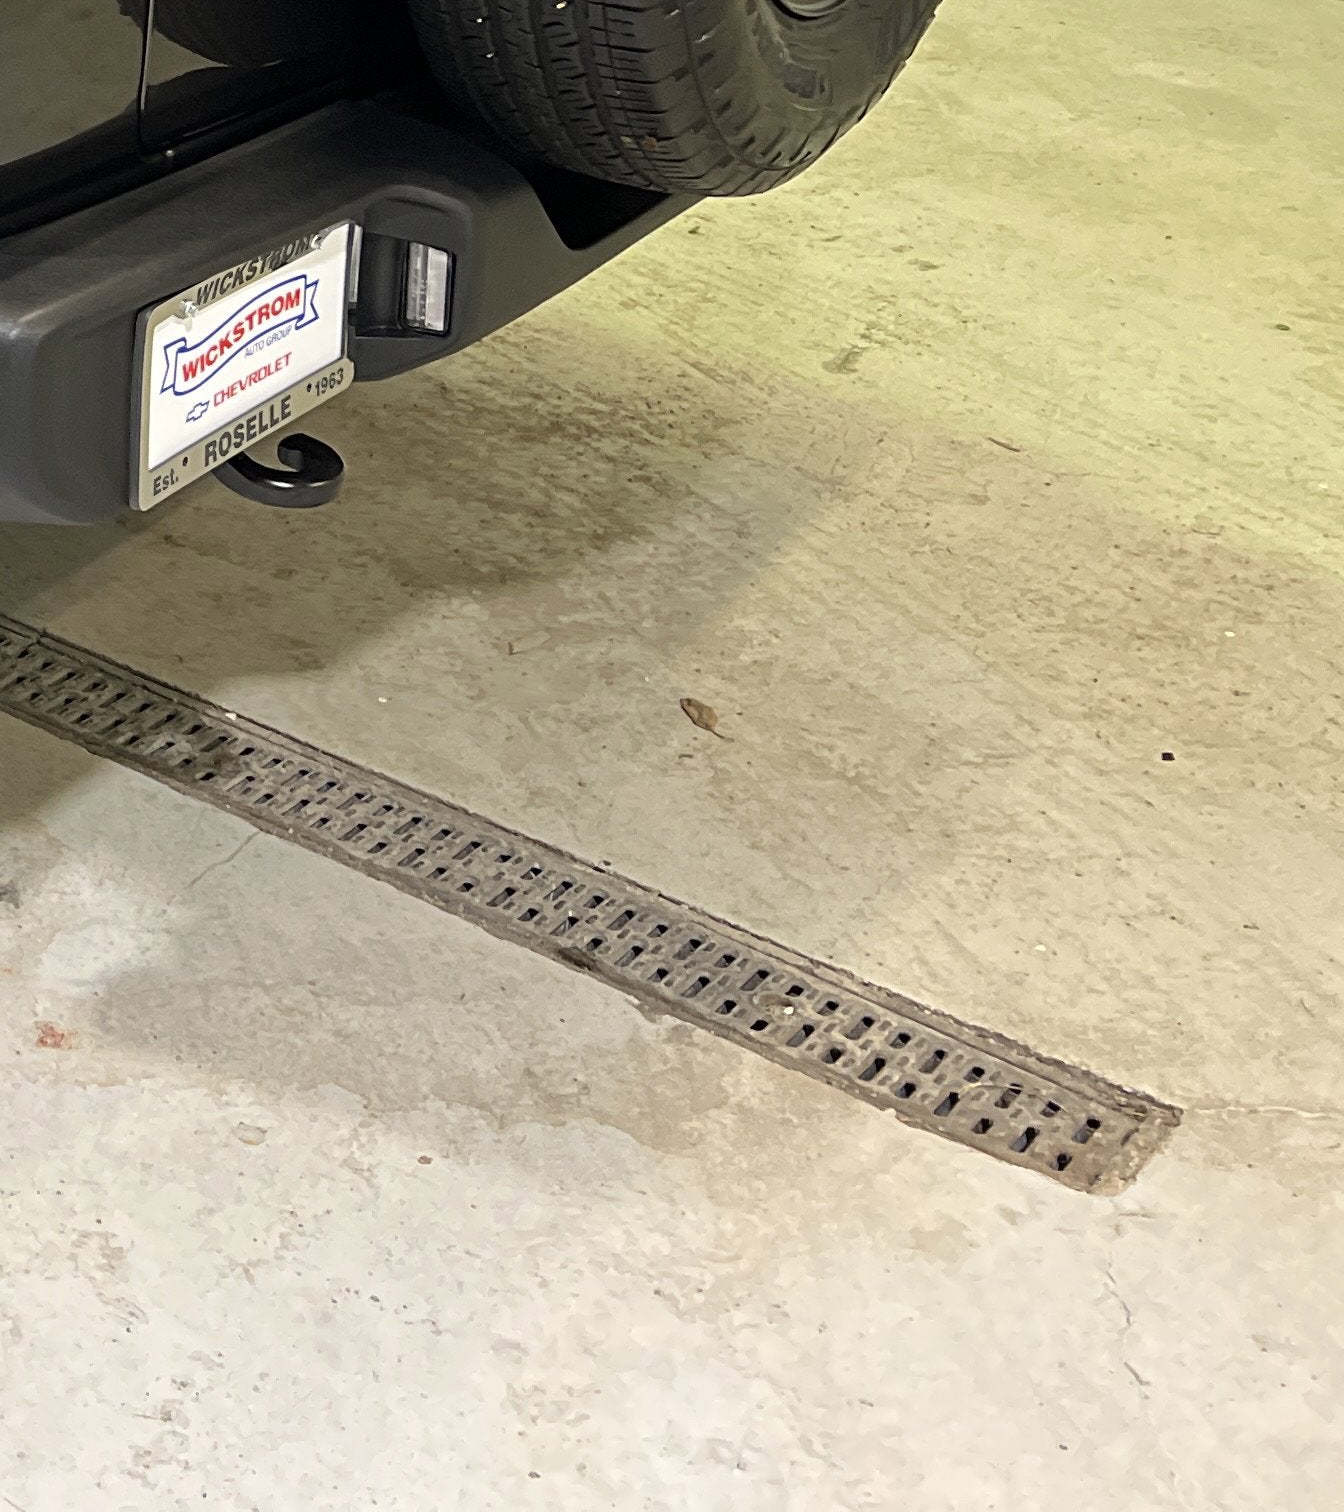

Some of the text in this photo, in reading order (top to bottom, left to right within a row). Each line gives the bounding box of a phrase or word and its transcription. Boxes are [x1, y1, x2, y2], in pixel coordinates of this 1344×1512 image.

[181, 288, 301, 382] WICKSTROM
[244, 325, 293, 359] AUTO GROUP
[213, 351, 292, 407] CHEVROLET
[153, 367, 345, 497] Est. ROSELLE 1963
